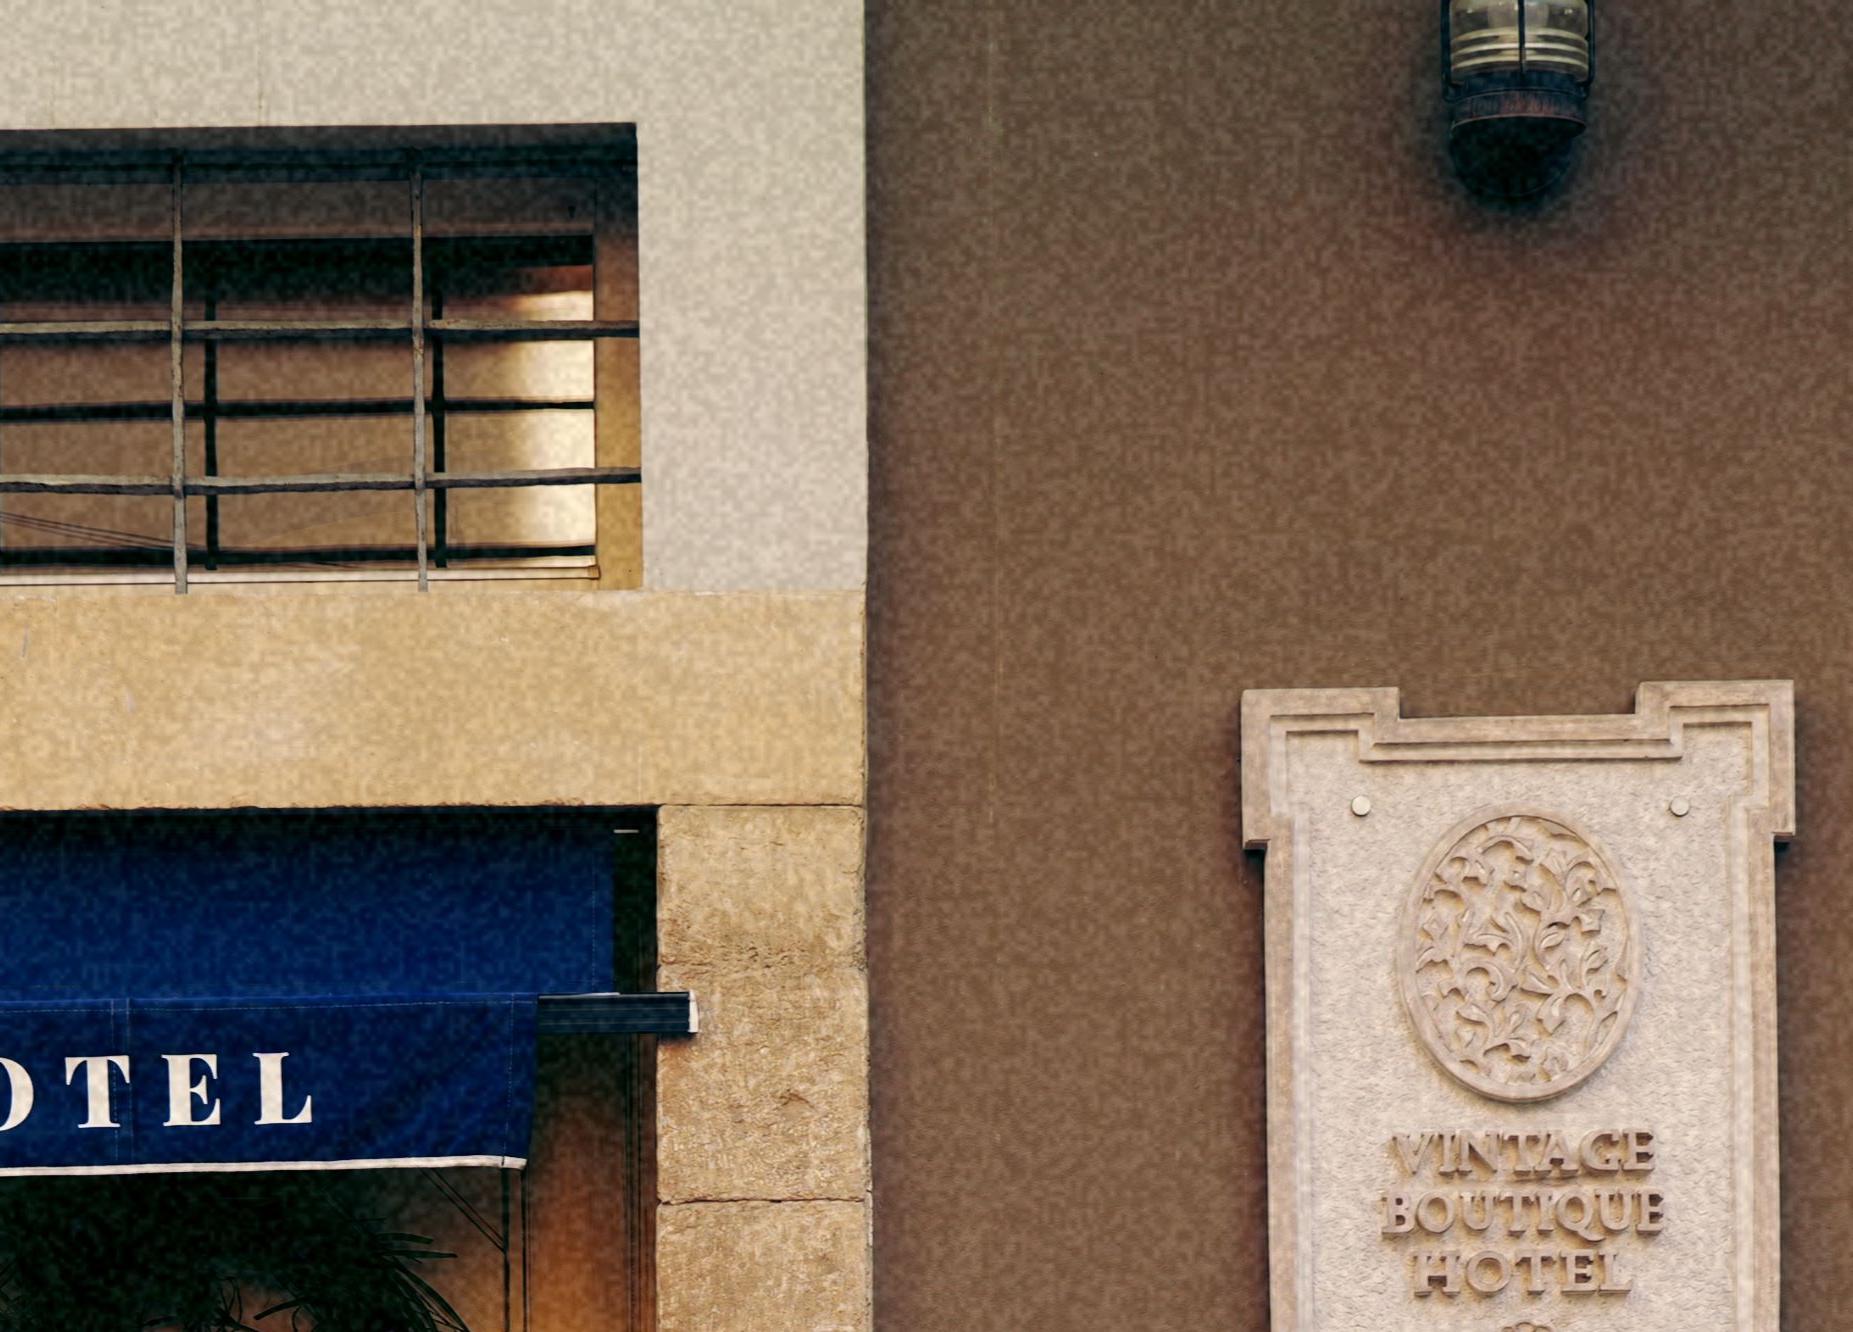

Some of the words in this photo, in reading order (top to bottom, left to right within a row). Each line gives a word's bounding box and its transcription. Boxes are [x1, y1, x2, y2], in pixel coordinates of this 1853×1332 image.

[1392, 1127, 1655, 1175] VINTAGE
[1381, 1188, 1665, 1243] BOUTIQUE
[1412, 1250, 1632, 1297] HOTEL
